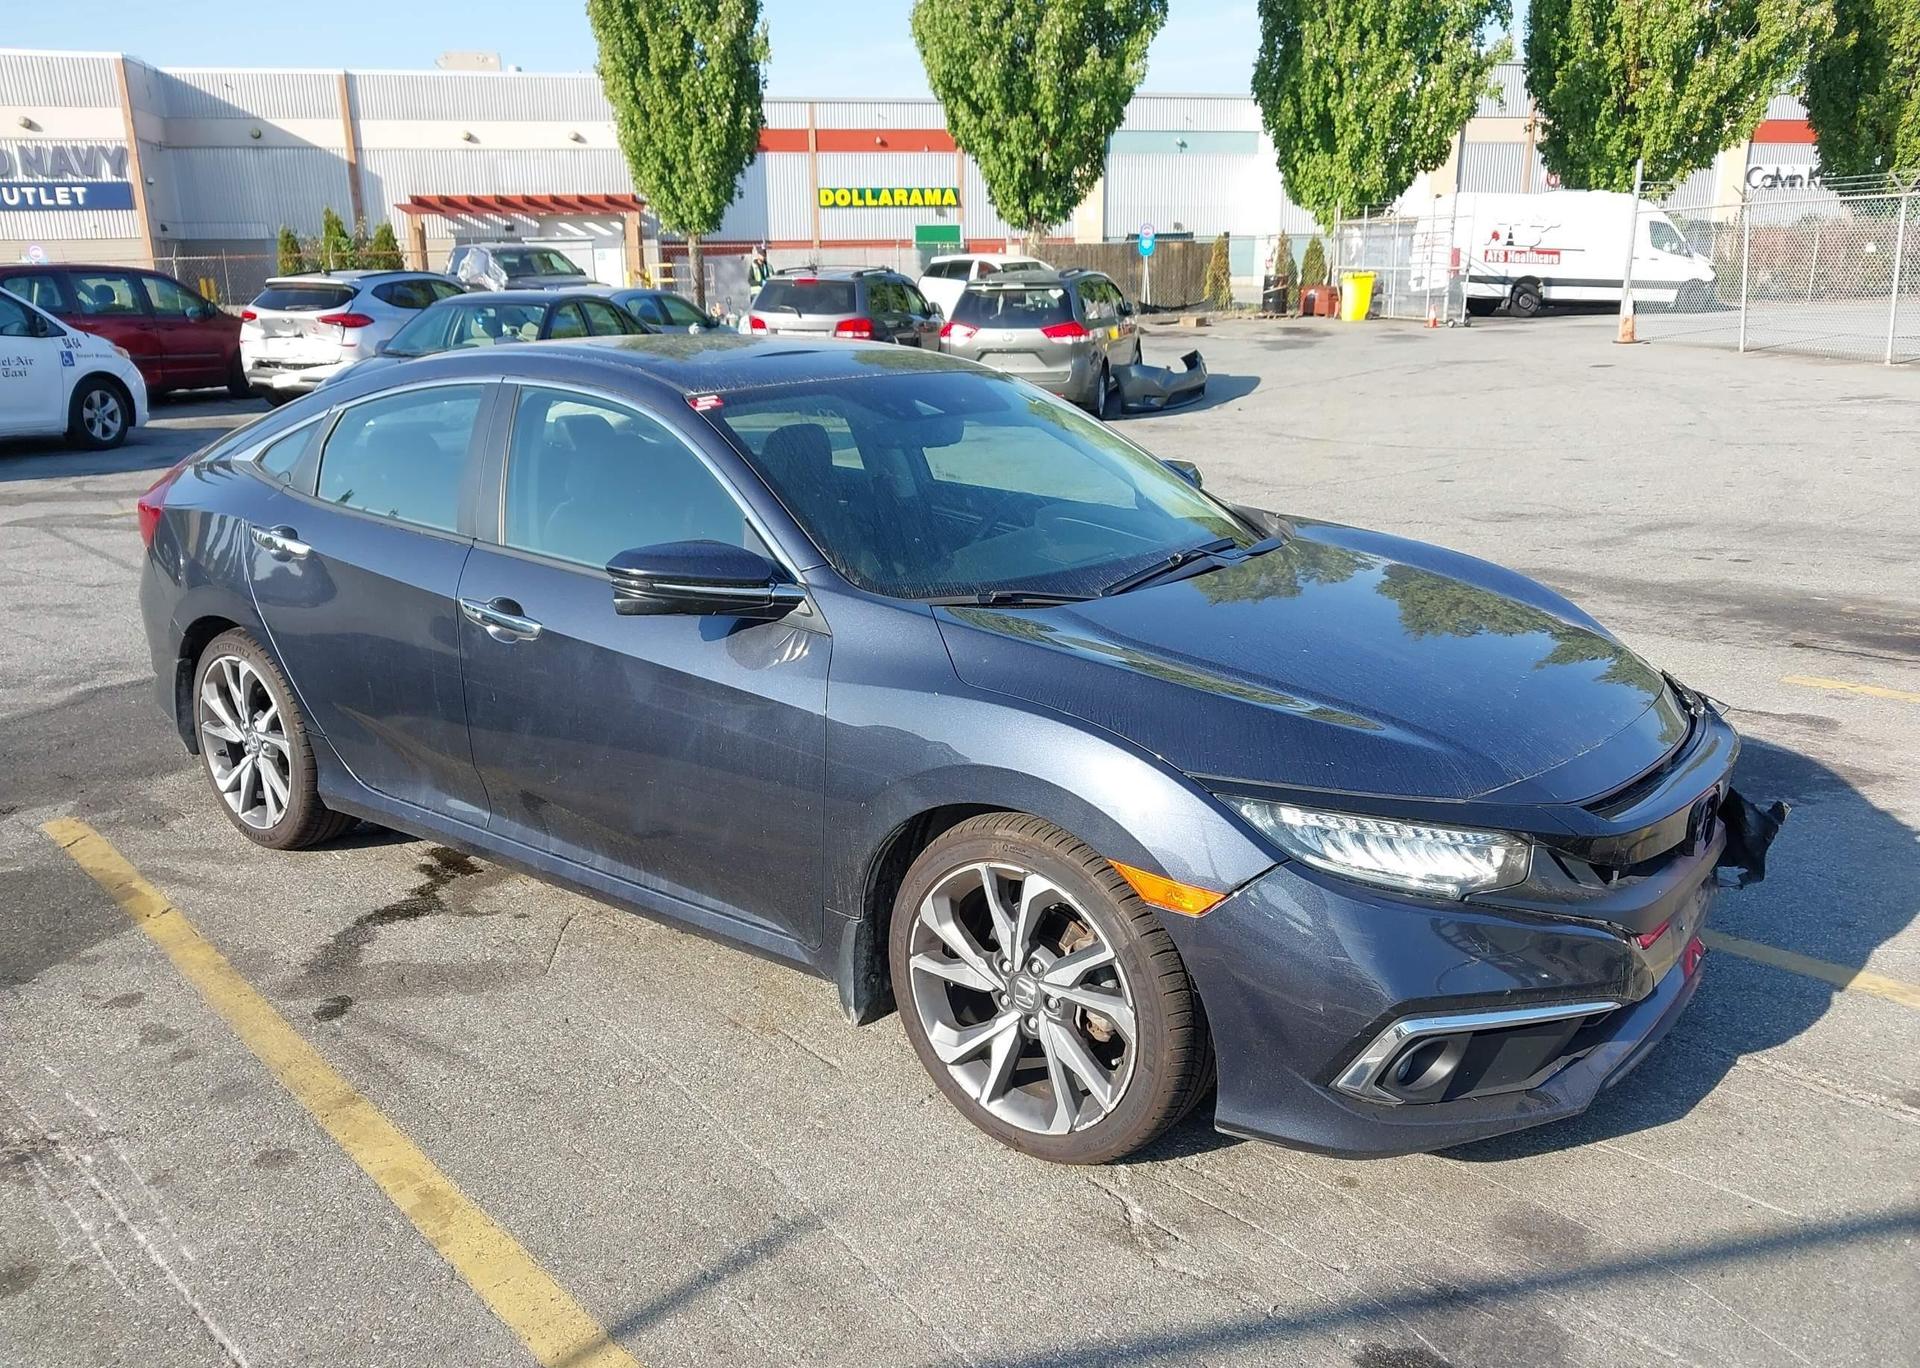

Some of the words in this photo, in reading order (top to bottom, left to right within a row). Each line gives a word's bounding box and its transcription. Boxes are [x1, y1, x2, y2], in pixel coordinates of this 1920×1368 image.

[18, 145, 127, 178] NAVY
[1746, 166, 1803, 188] Calvin
[0, 187, 87, 206] UTLET
[819, 188, 957, 207] DOLLARAMA
[1486, 250, 1505, 262] ATS
[1507, 250, 1559, 264] Healthcare
[0, 356, 34, 366] el-Air
[1, 367, 27, 378] Taxi
